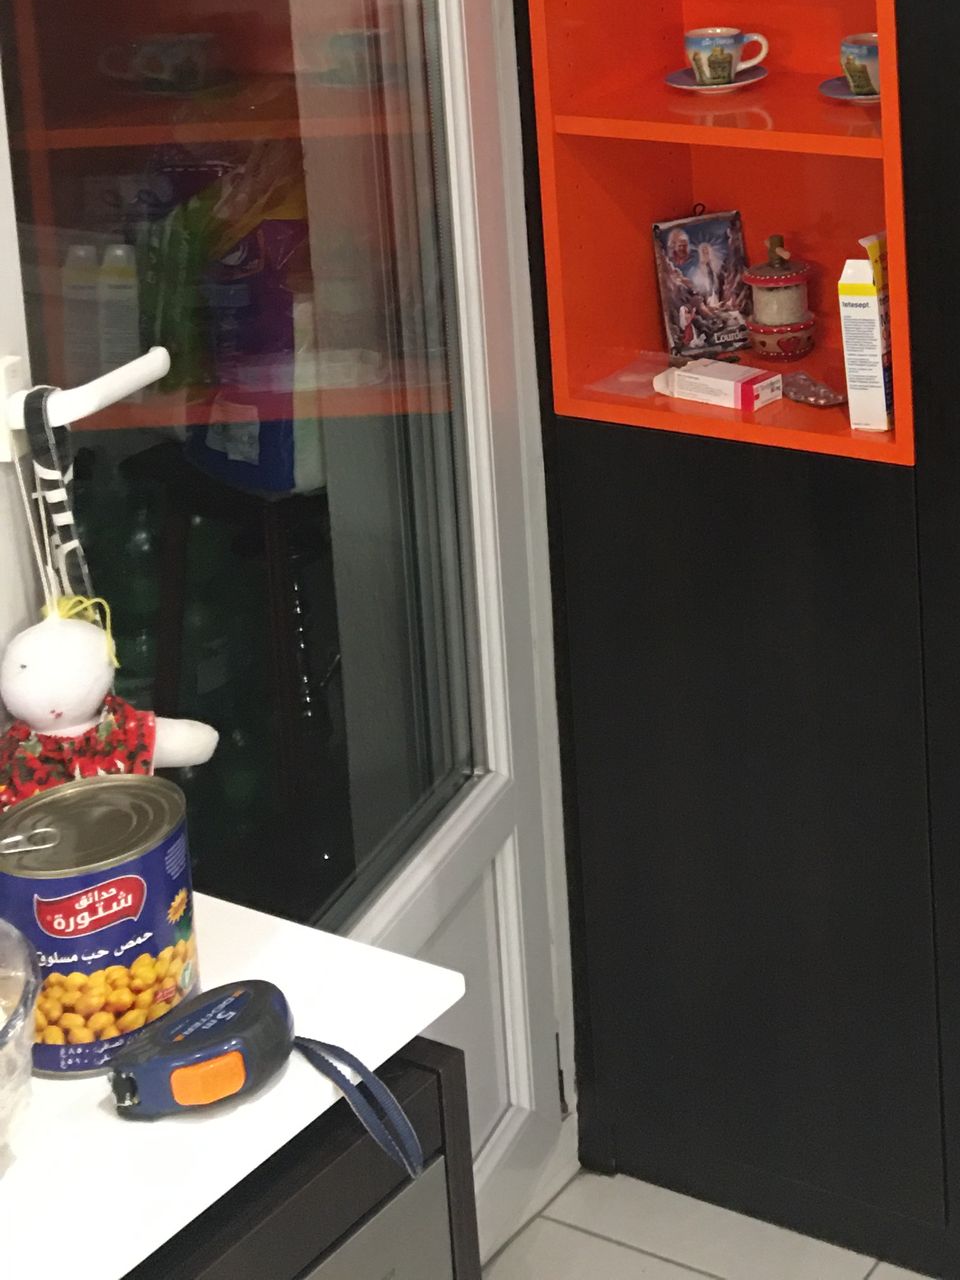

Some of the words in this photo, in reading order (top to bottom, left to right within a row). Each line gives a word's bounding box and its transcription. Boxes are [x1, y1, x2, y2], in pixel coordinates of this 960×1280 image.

[74, 887, 118, 910] حدائق
[53, 890, 133, 933] شتورة
[113, 931, 154, 957] حمص
[81, 948, 110, 965] حب
